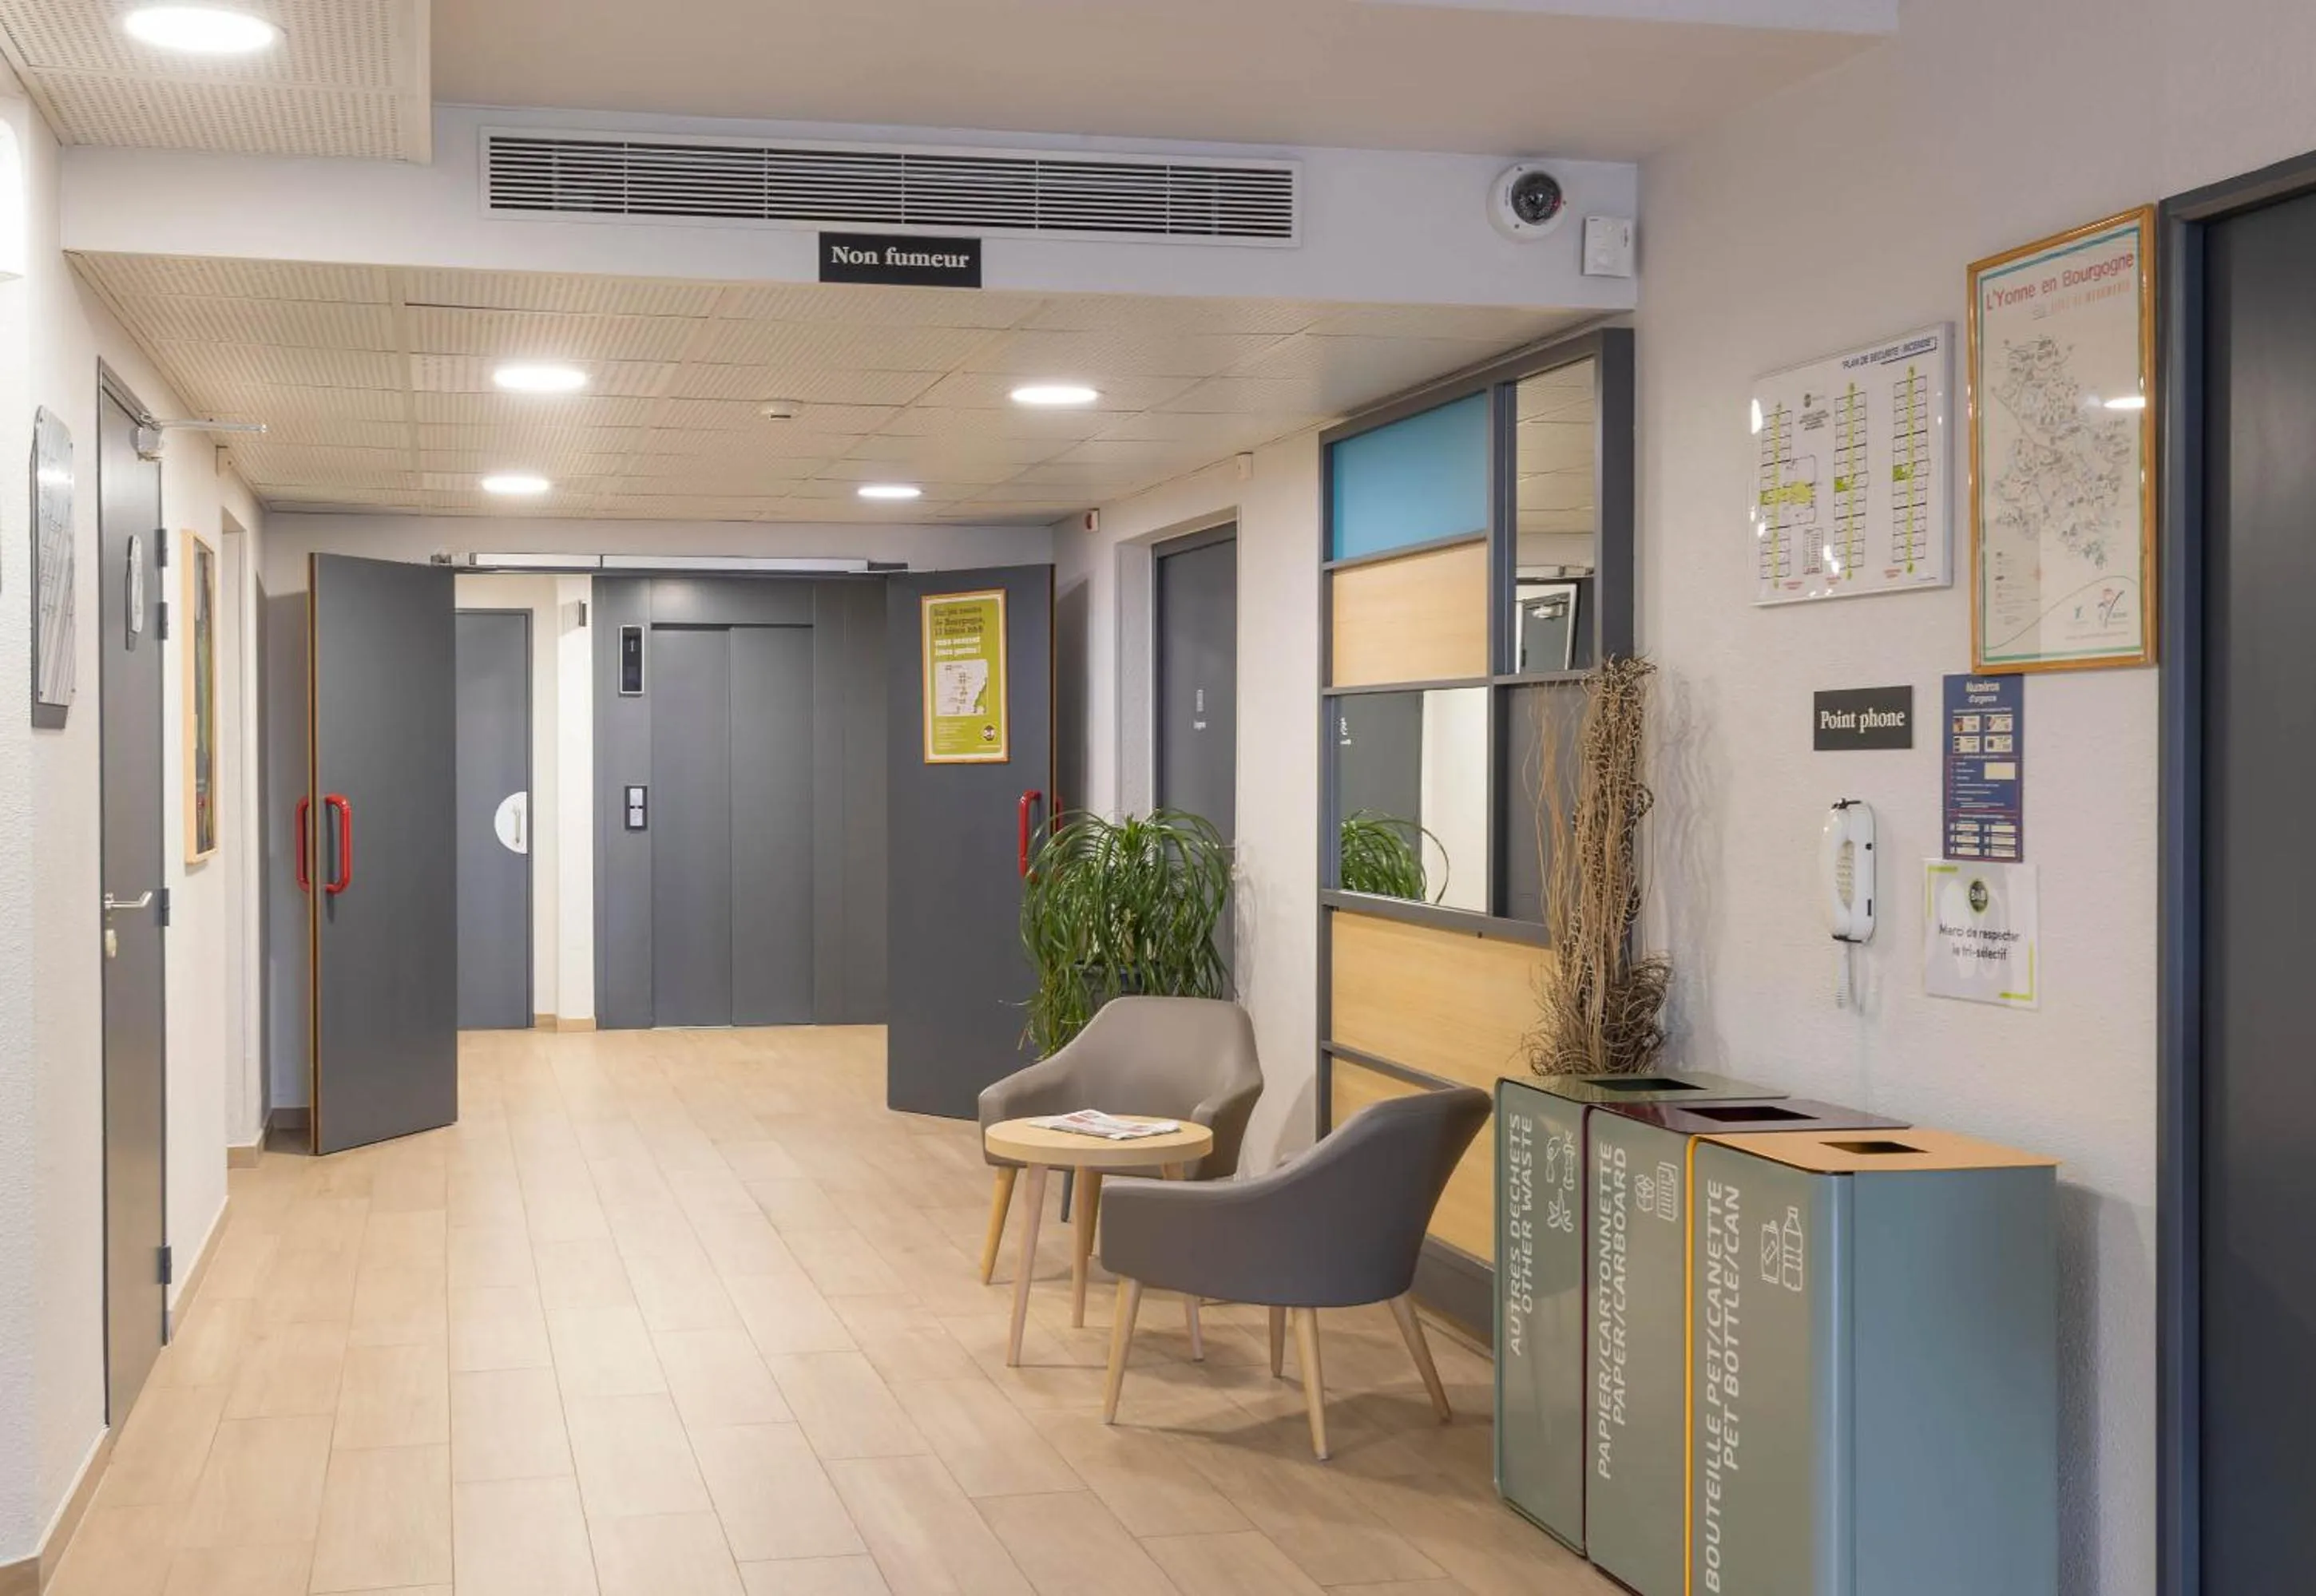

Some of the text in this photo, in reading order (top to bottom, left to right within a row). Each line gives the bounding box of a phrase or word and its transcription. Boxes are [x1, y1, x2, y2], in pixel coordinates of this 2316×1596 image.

[831, 246, 970, 267] Non fumeur
[1985, 284, 2036, 311] L'Yonne
[2042, 277, 2058, 294] en
[2062, 252, 2134, 287] Bourgogne
[1820, 707, 1906, 733] Point phone
[1521, 1116, 1533, 1314] OTHER WASTE
[1509, 1246, 1521, 1356] AUTRES
[1598, 1140, 1612, 1479] PAPIER/CARTONNETTE
[1723, 1184, 1740, 1471] PET BOTTLE/CAN
[1705, 1178, 1723, 1594] BOUTEILLE PET/CANETTE
